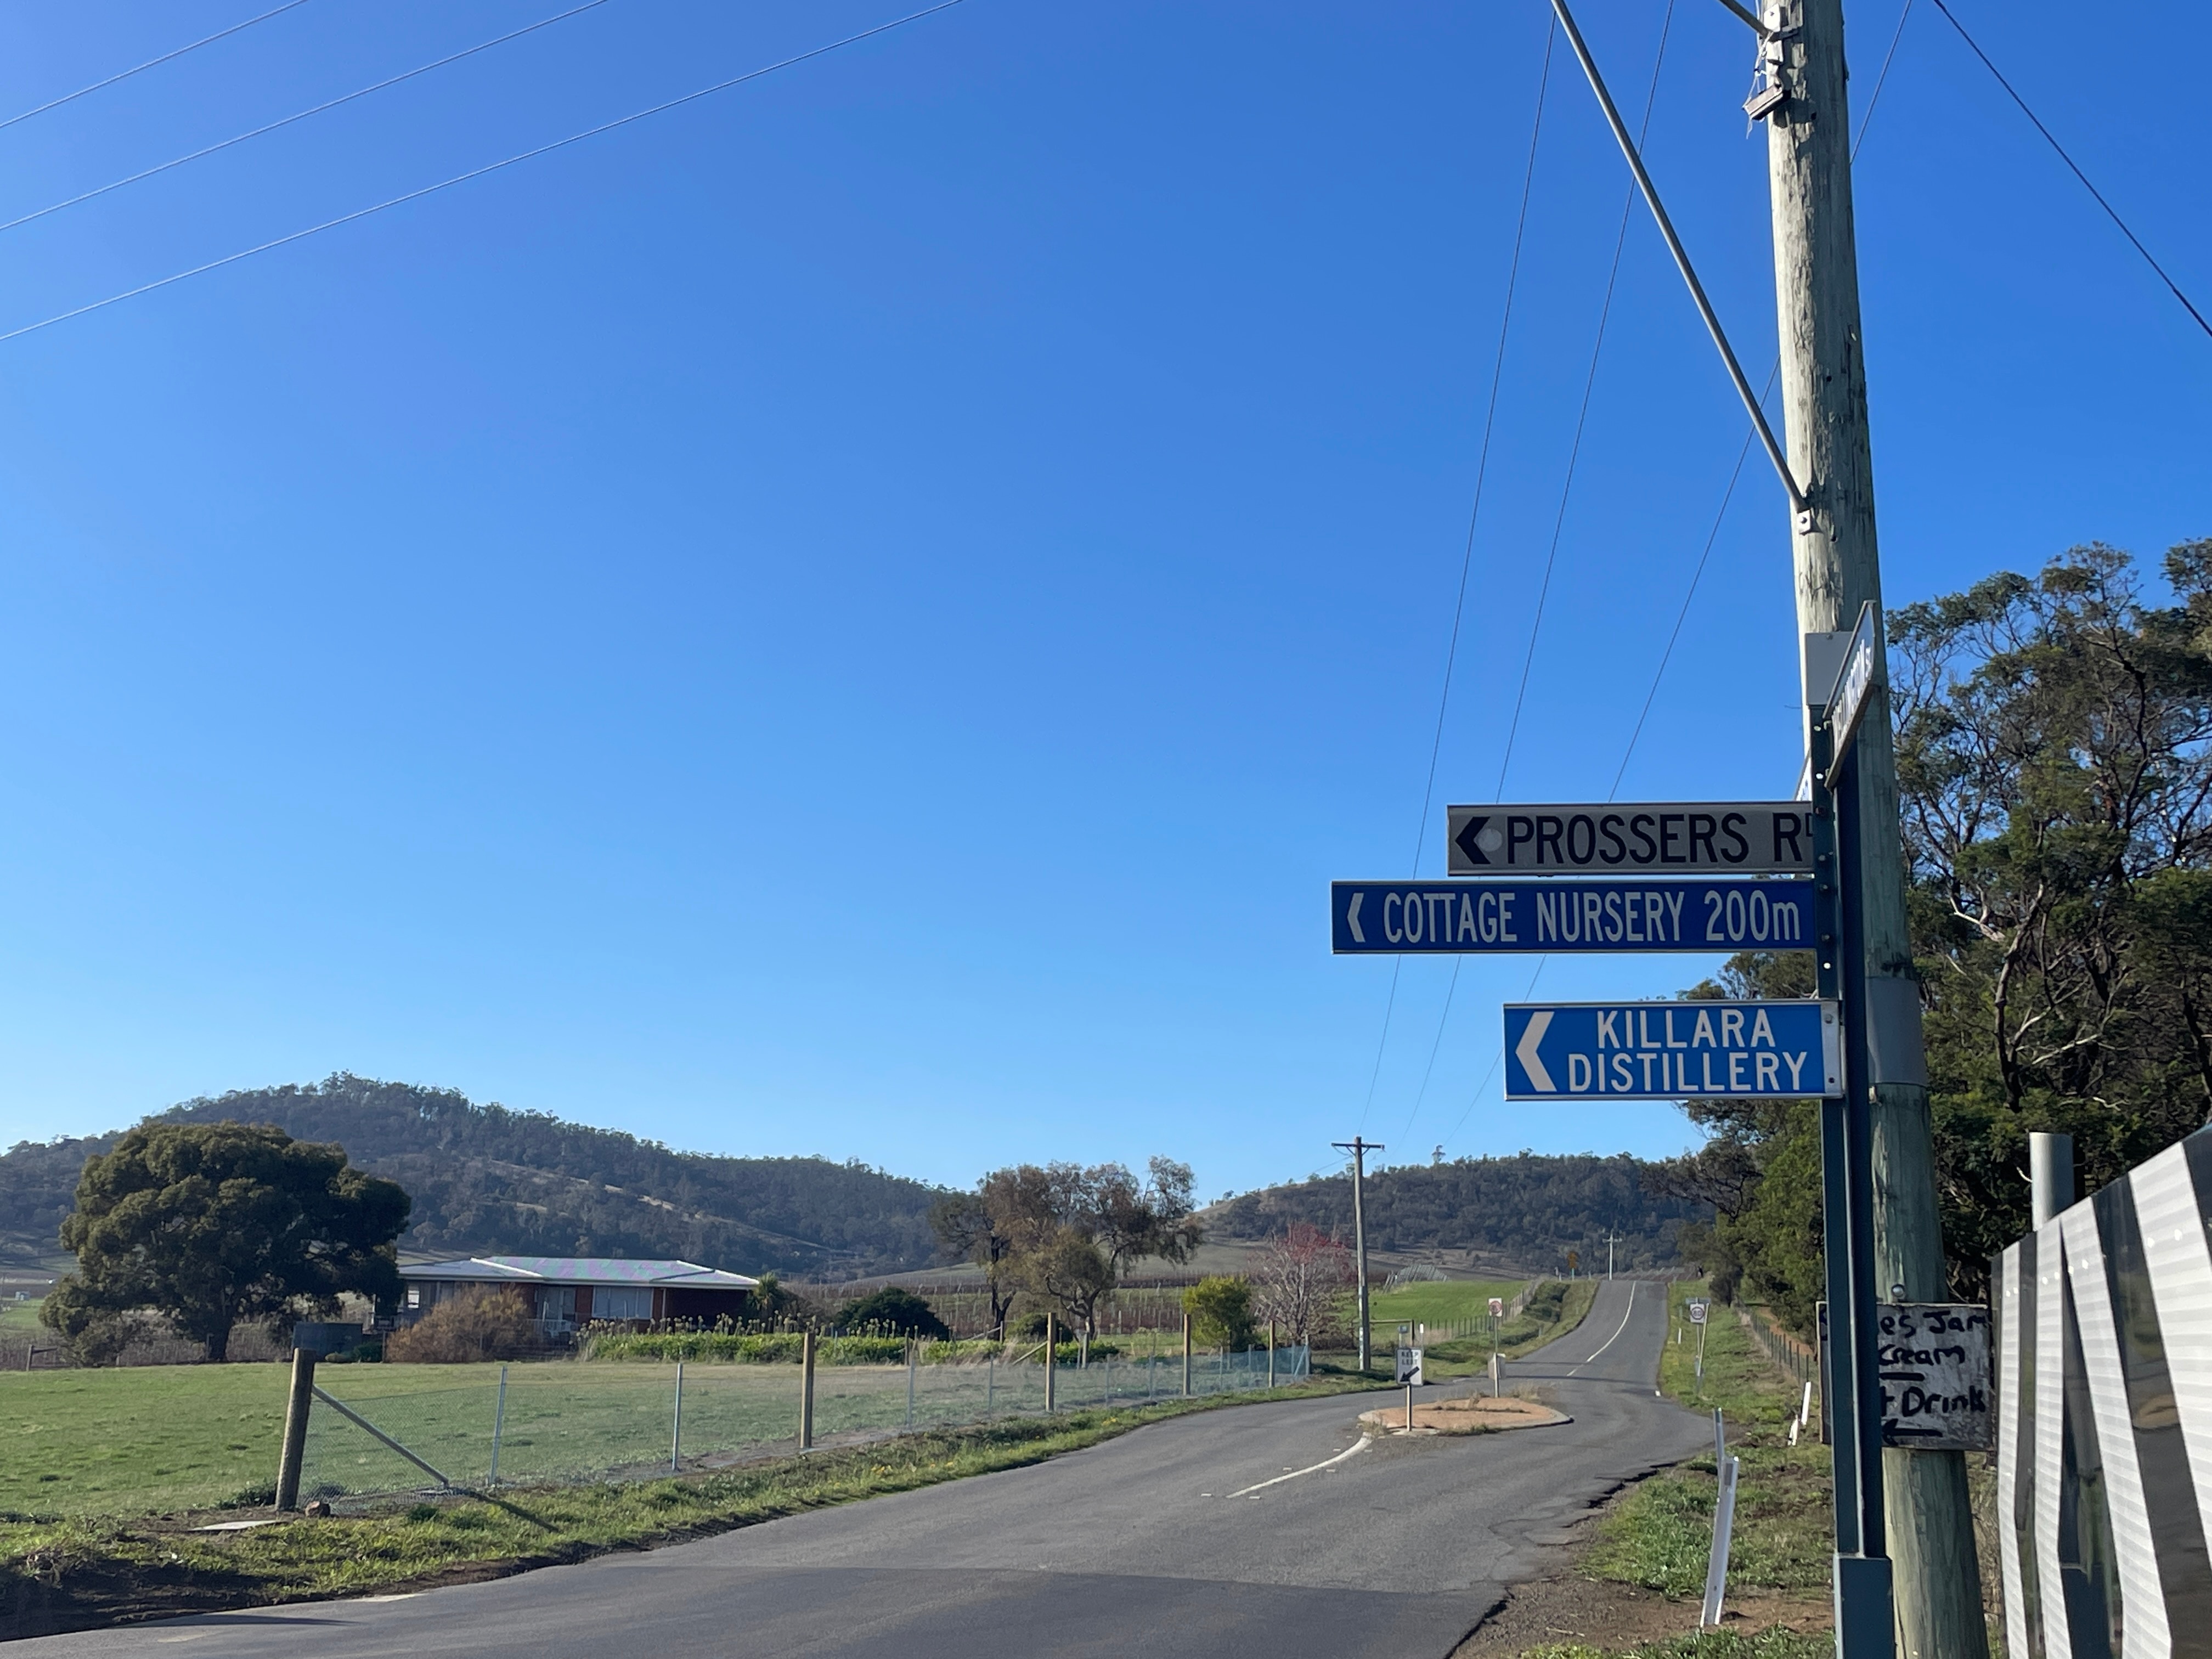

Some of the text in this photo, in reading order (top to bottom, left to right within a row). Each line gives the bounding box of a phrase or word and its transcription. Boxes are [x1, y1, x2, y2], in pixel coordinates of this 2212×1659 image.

[1506, 812, 1749, 865] PROSSERS
[1384, 889, 1801, 943] COTTAGE NURSERY 200m
[1597, 1008, 1775, 1049] KILLARA
[1568, 1051, 1807, 1093] DISTILLERY
[1902, 1385, 1985, 1417] Drink
